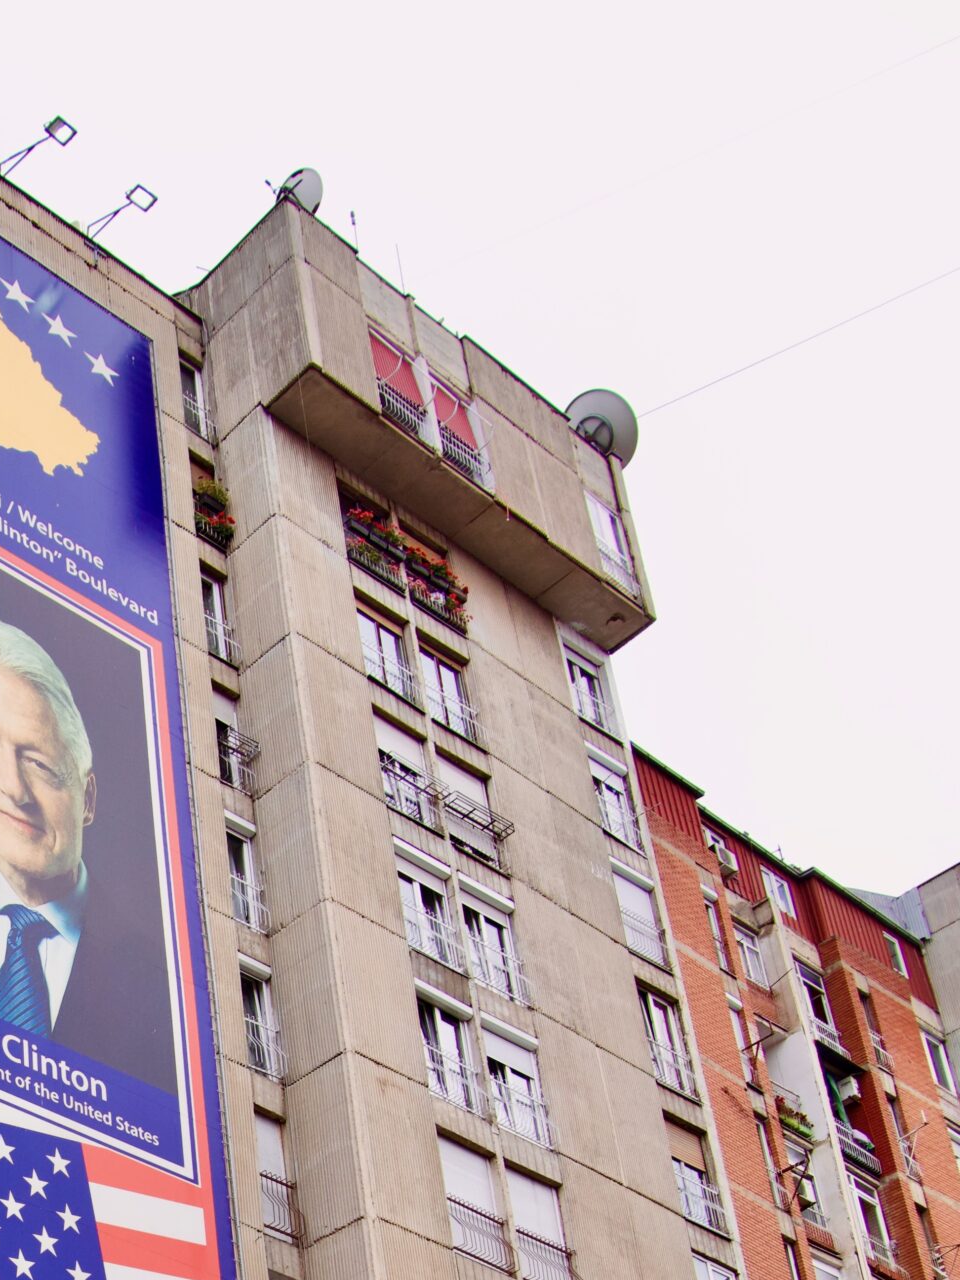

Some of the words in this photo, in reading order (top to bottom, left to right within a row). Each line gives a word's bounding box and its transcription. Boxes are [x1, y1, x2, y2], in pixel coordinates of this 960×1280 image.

[17, 504, 105, 570] Welcome
[65, 557, 159, 626] Boulevard
[2, 1034, 108, 1101] Clinton
[15, 1071, 33, 1091] of
[34, 1079, 59, 1104] the
[62, 1088, 113, 1127] United
[116, 1115, 160, 1146] States
